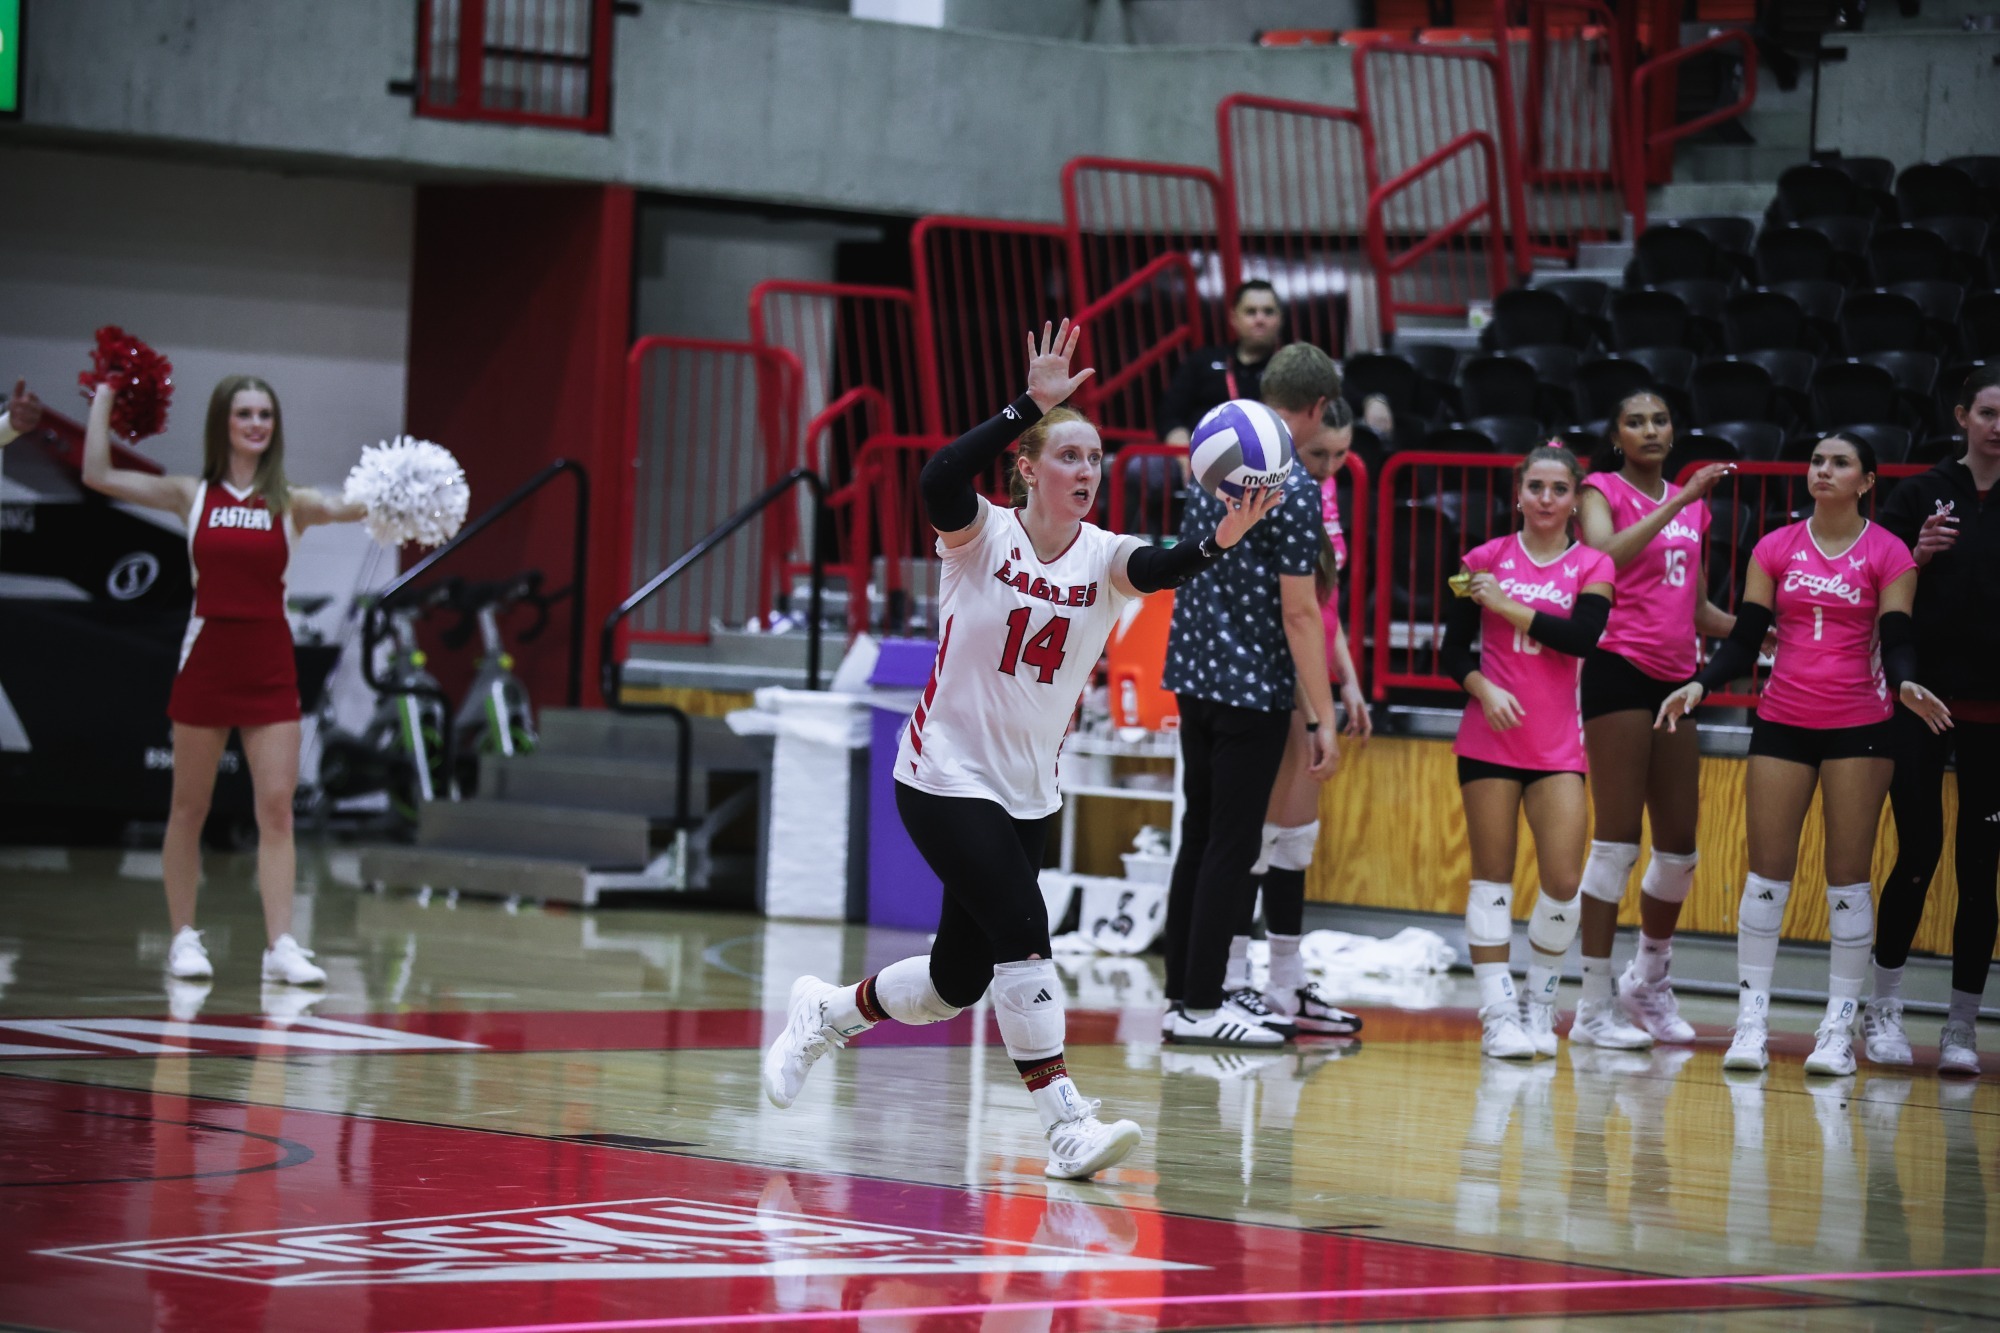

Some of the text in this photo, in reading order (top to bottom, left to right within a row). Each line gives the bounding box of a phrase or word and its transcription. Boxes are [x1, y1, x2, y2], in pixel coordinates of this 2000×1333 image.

[1242, 469, 1290, 485] molten
[208, 506, 273, 531] EASTERN
[994, 559, 1098, 608] EAGLES
[1661, 549, 1687, 588] 16
[1500, 577, 1573, 610] Eagles
[1784, 570, 1861, 605] Eagles
[1812, 606, 1823, 641] 1
[997, 606, 1071, 685] 14
